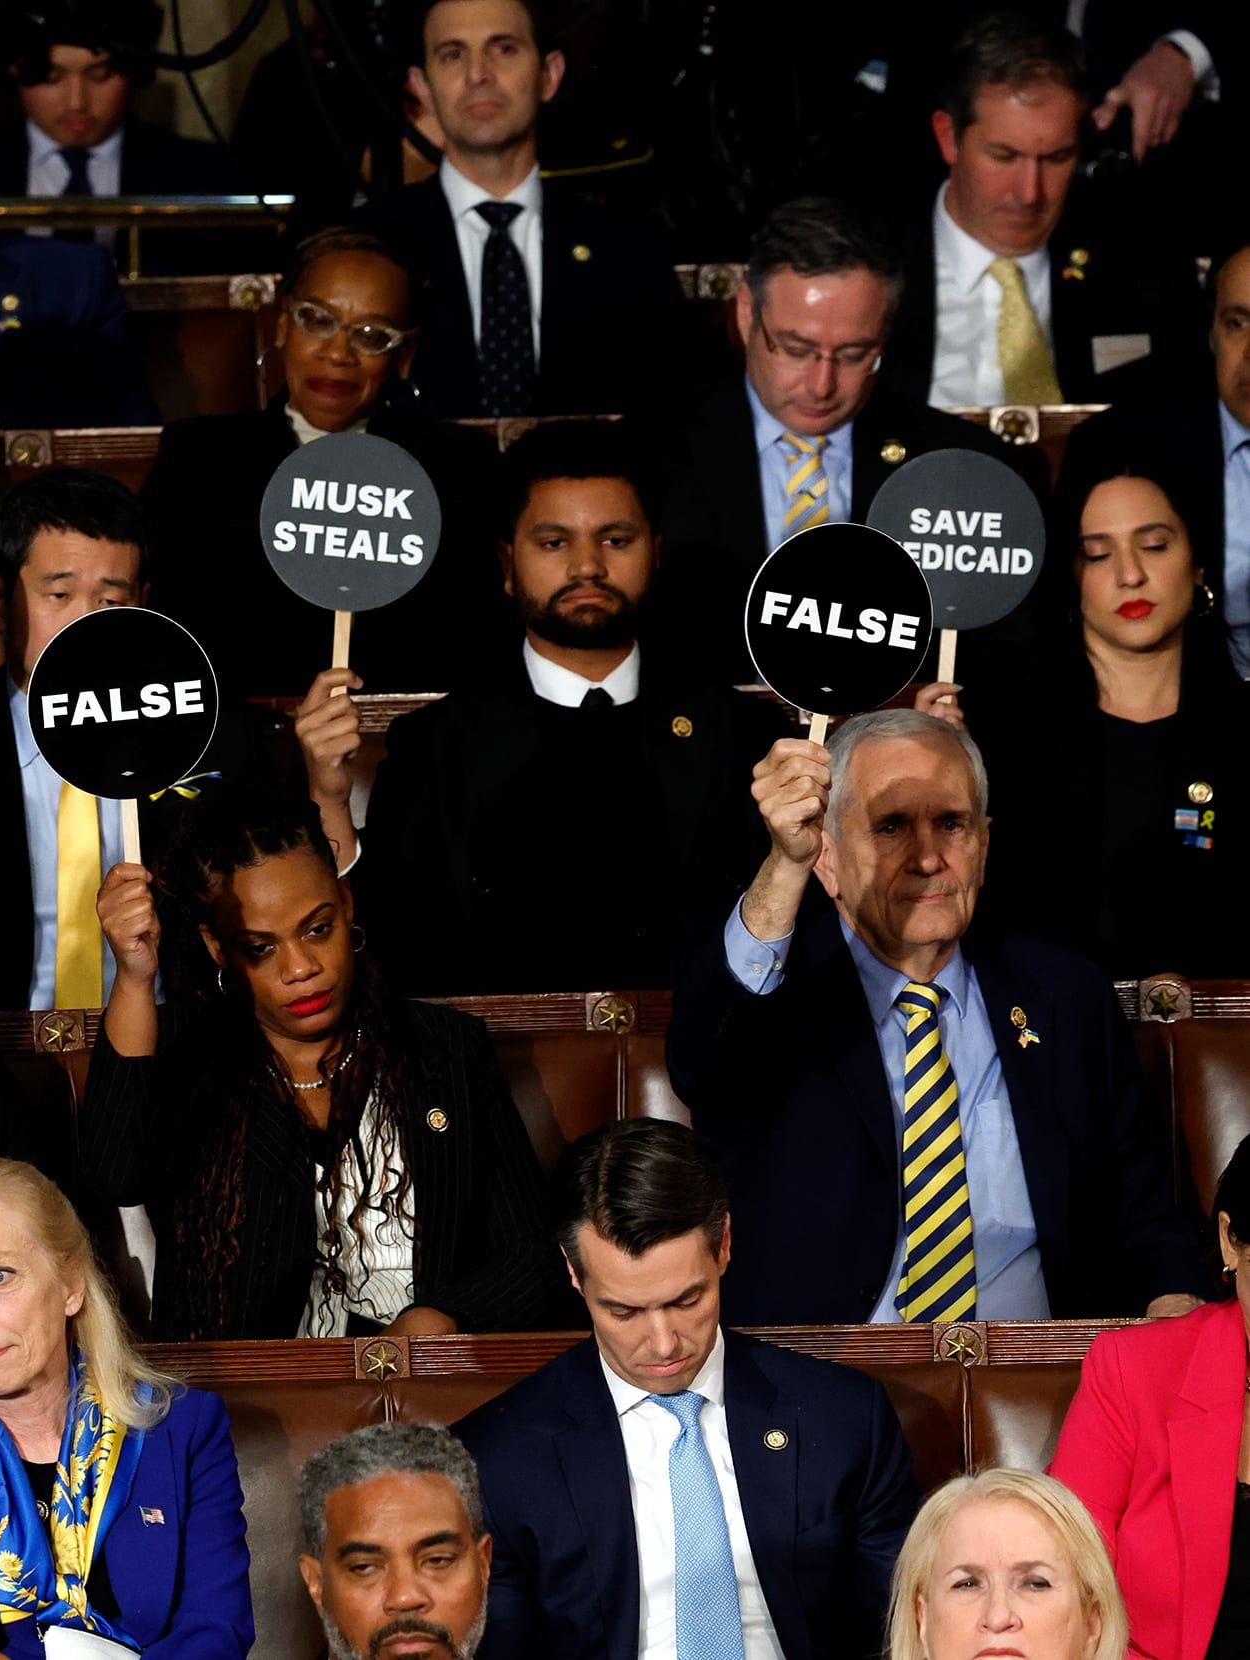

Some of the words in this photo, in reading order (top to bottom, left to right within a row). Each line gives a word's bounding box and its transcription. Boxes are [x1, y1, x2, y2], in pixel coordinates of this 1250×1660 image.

[291, 477, 414, 519] MUSK
[272, 520, 424, 566] STEALS
[909, 507, 1003, 538] SAVE
[896, 541, 1034, 576] EDICAID
[760, 590, 921, 650] FALSE
[41, 679, 205, 729] FALSE
